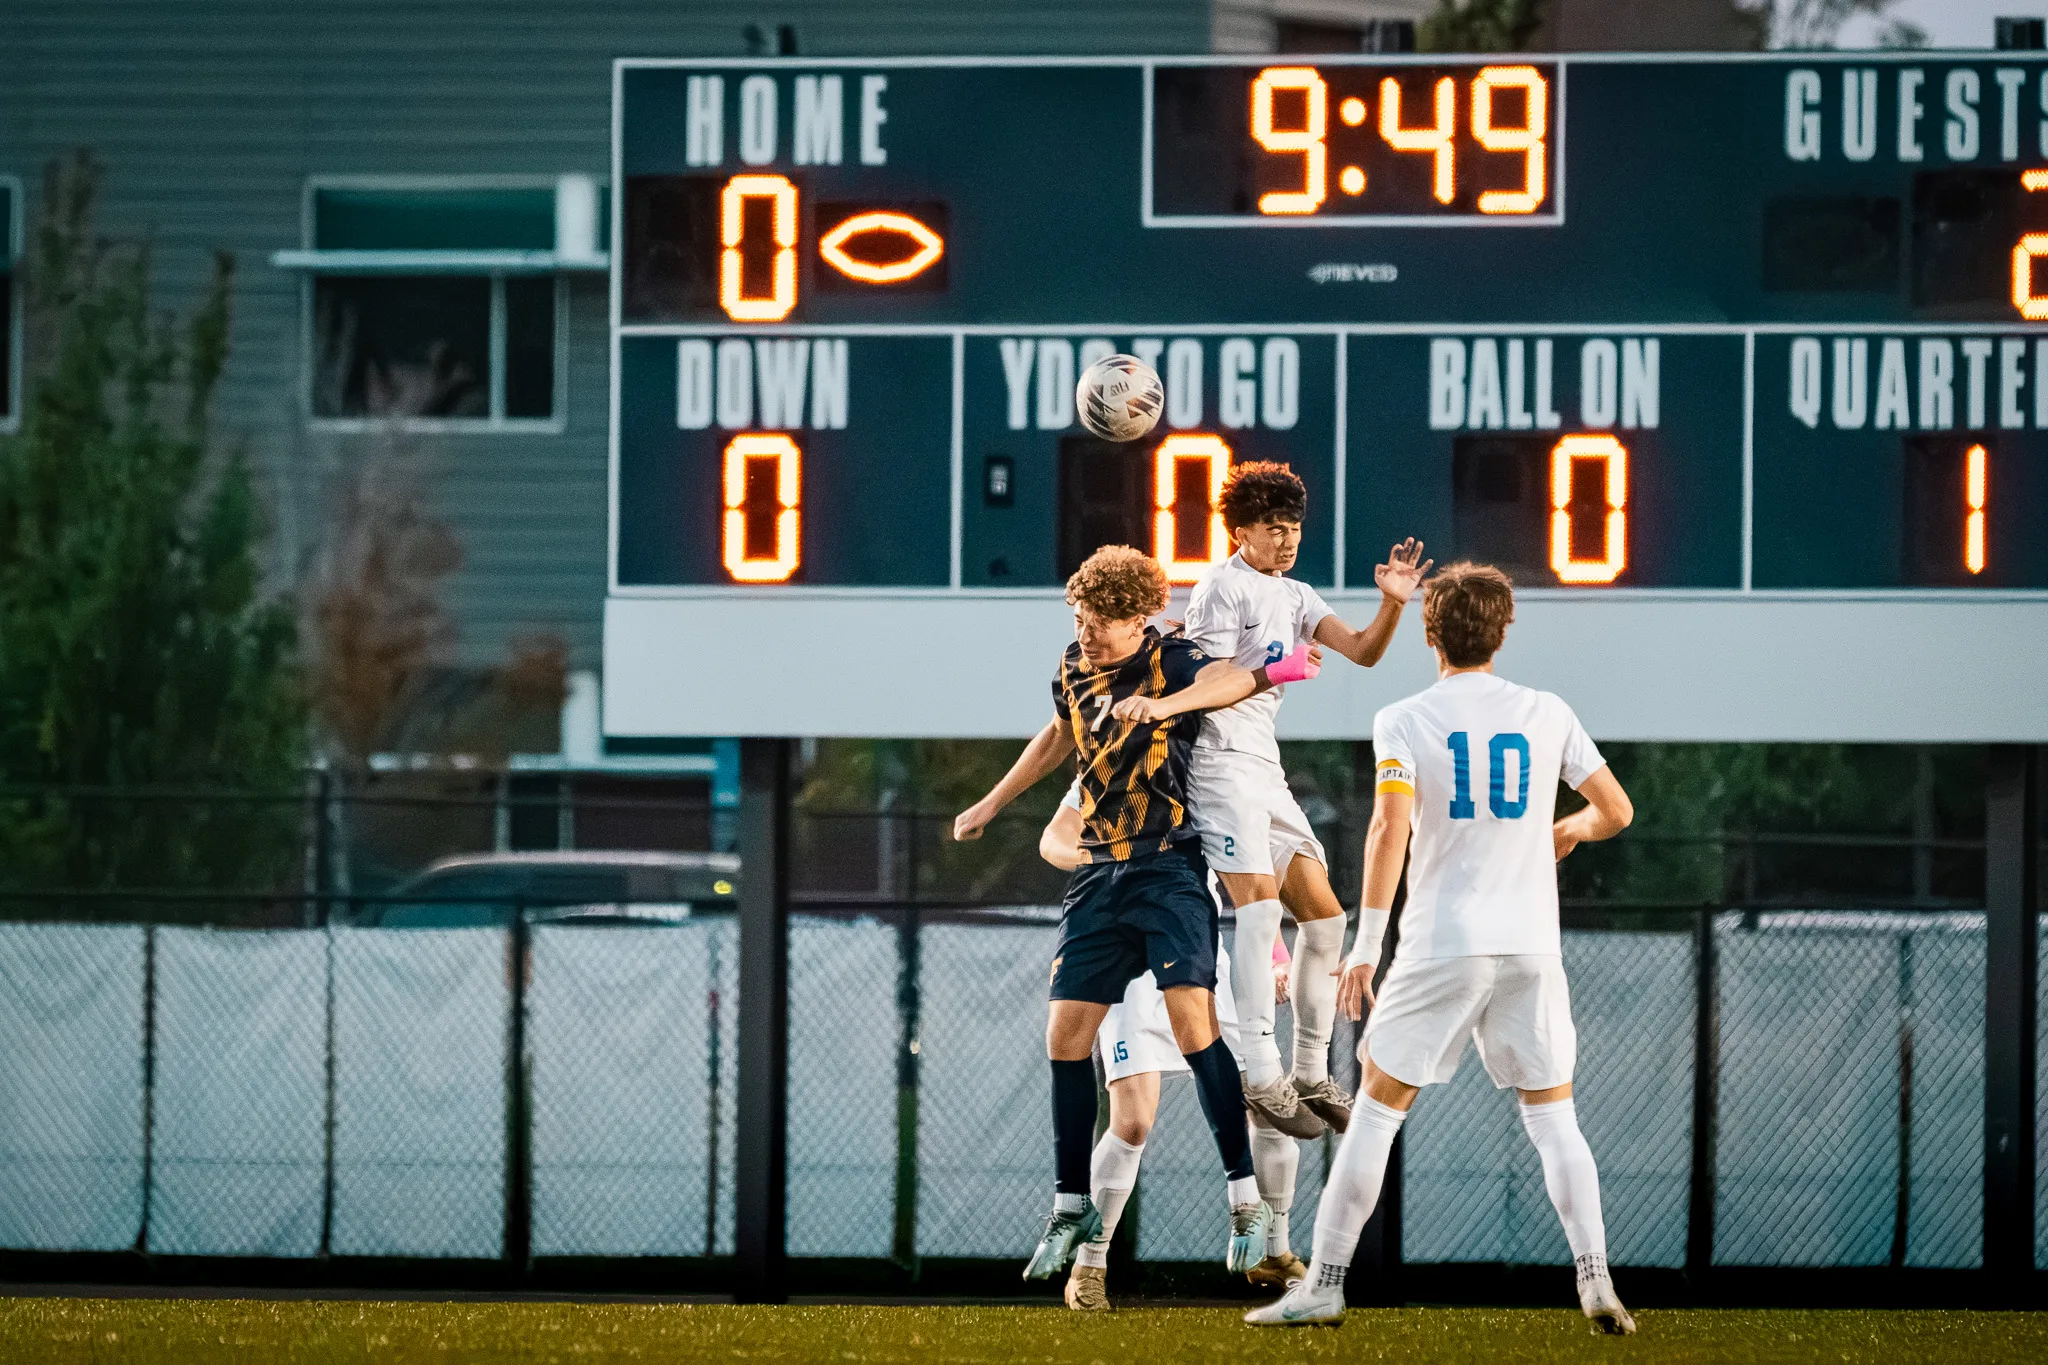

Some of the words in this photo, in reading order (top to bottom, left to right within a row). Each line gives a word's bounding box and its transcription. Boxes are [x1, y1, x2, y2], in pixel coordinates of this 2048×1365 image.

[687, 75, 887, 165] HOME
[1250, 65, 1547, 215] 9:49
[1786, 68, 2048, 161] GUEST
[720, 174, 798, 322] 0
[677, 338, 848, 430] DOWN
[1001, 338, 1116, 430] YD
[1218, 337, 1300, 430] GO
[1429, 338, 1561, 430] BALL
[1580, 338, 1660, 430] ON
[722, 433, 802, 582] 0
[1155, 433, 1232, 584] 0
[1549, 433, 1629, 583] 0
[1965, 444, 1987, 574] 1
[1264, 640, 1284, 667] 2
[1090, 694, 1113, 732] 7
[1447, 731, 1531, 820] 10
[1224, 836, 1235, 857] 2
[1113, 1040, 1129, 1064] 15
